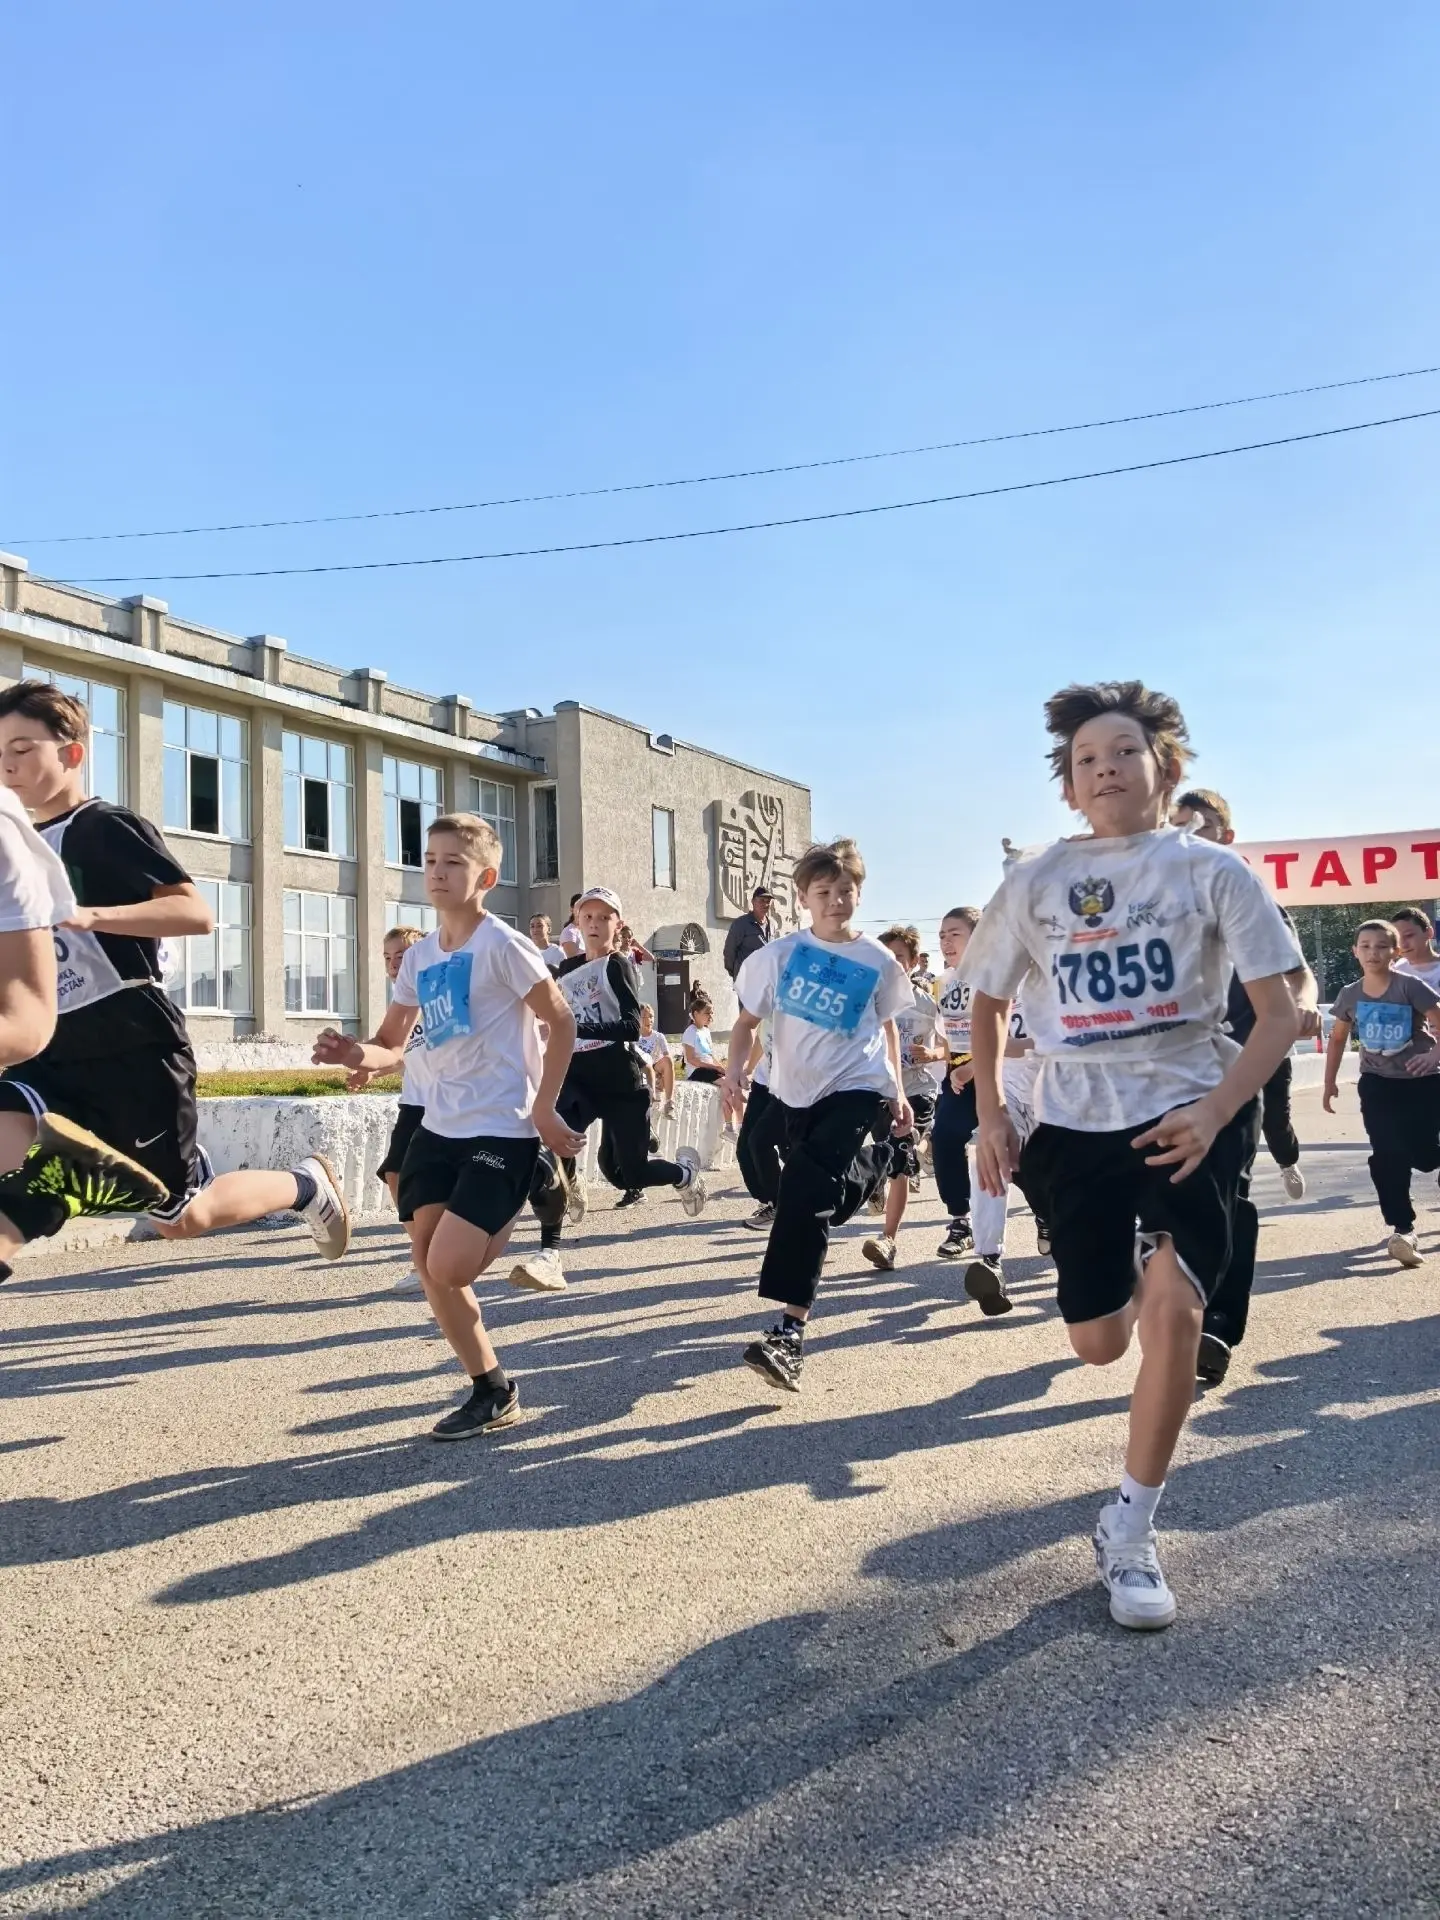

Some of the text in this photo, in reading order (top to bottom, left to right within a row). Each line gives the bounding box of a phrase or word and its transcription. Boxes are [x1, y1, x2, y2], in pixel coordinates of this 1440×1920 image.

[1243, 842, 1440, 889] ТАРТ
[424, 989, 455, 1029] 8704
[788, 976, 848, 1017] 8755
[1366, 1023, 1404, 1040] 8750
